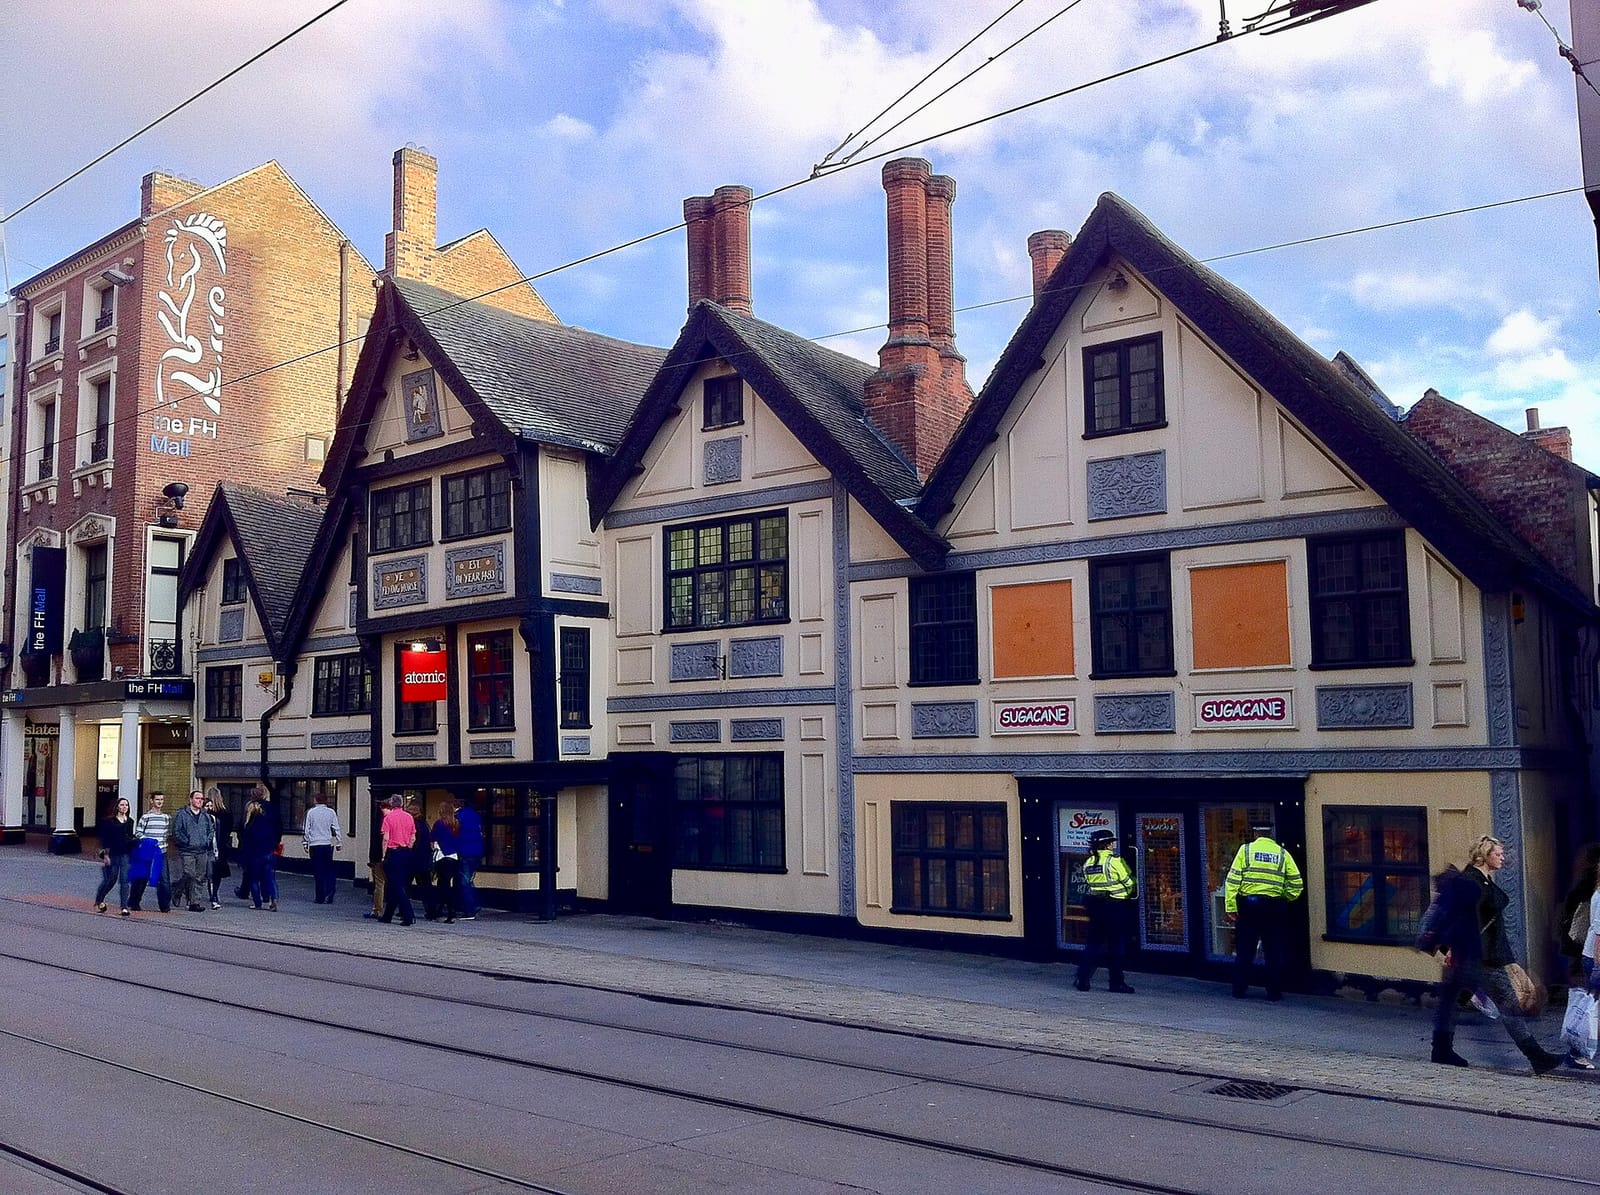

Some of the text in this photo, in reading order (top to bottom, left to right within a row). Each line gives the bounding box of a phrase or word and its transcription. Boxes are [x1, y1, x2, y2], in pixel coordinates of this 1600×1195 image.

[153, 415, 218, 439] the FH
[150, 433, 191, 457] Mall
[463, 571, 481, 583] YEAR
[33, 631, 45, 650] the
[404, 669, 446, 684] atomic
[128, 683, 144, 693] the
[1001, 707, 1067, 724] SUGACANE
[1203, 701, 1282, 718] SUGACANE
[1069, 812, 1110, 829] Shake
